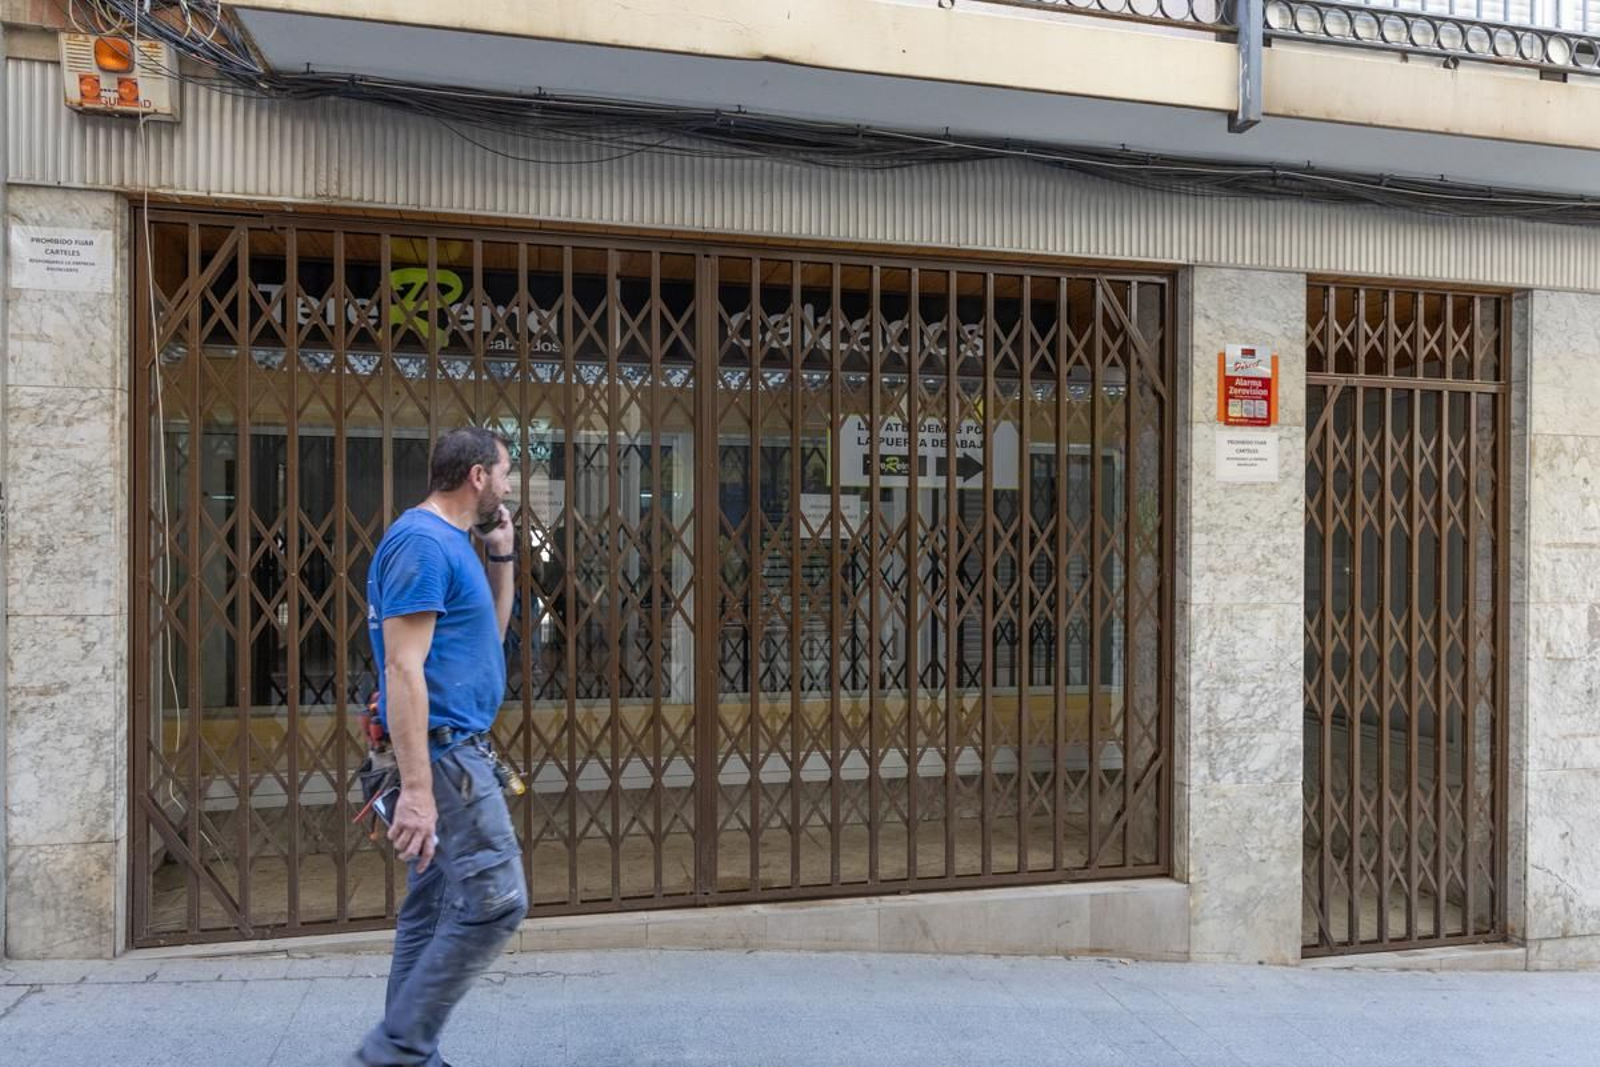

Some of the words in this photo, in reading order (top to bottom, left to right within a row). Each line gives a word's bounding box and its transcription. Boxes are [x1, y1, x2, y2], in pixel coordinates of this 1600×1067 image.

[31, 237, 73, 246] PROHIBIDO
[44, 248, 81, 257] CARTELES
[489, 338, 561, 353] calzdos
[1235, 378, 1262, 387] Alarma
[1228, 386, 1268, 396] Zerovision
[879, 437, 928, 448] PUERA
[955, 439, 984, 450] ABAJ
